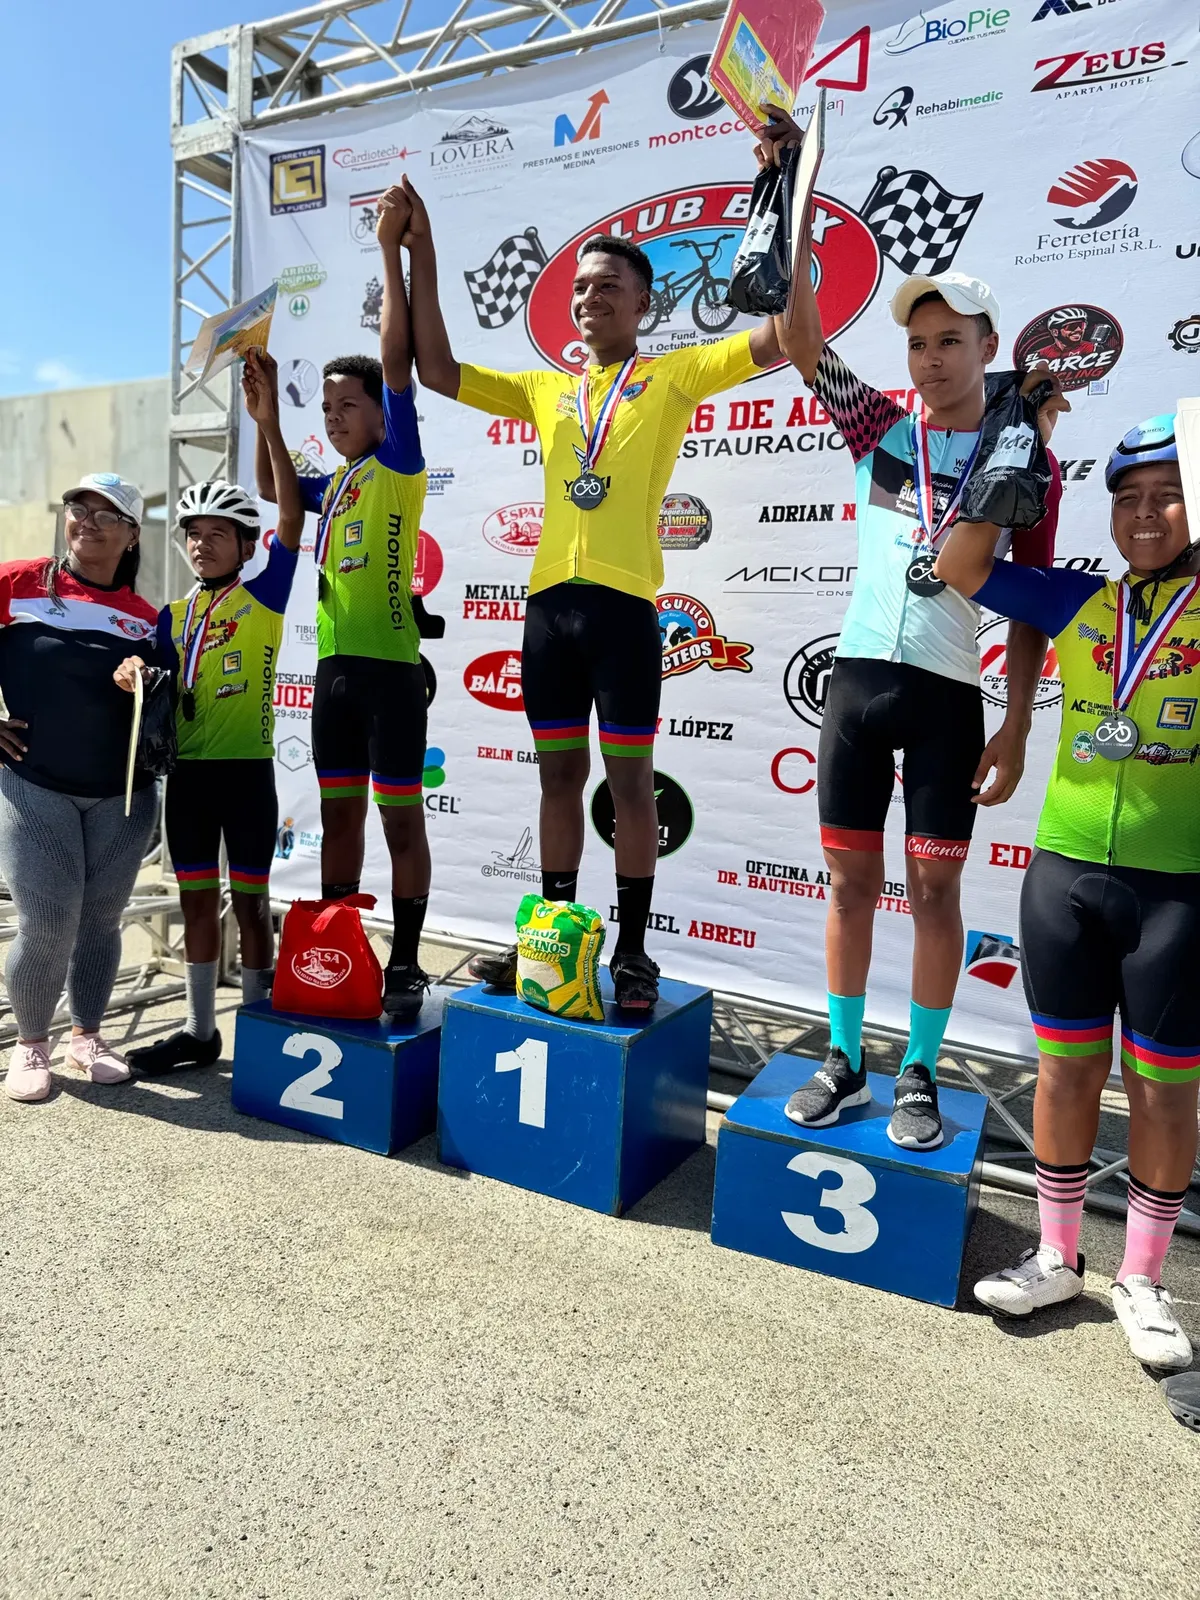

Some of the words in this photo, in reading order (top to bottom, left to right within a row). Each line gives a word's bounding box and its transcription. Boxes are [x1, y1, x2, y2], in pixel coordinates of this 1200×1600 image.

[925, 8, 1010, 43] BioPie
[1030, 41, 1166, 93] ZEUS
[1055, 85, 1104, 100] APARTA
[1110, 76, 1154, 90] HOTEL
[916, 91, 1003, 116] Rehabimedic
[342, 144, 400, 165] Cardiotech
[430, 137, 514, 167] LOVERA
[523, 152, 573, 169] PRESTAMOS
[582, 140, 640, 157] INVERSIONES
[563, 158, 596, 170] MEDINA
[288, 202, 323, 212] FUENTE
[1036, 223, 1141, 250] Ferretería
[1014, 250, 1064, 266] Roberto
[1068, 243, 1116, 260] Espinal
[1120, 239, 1162, 251] S.R.L.
[671, 331, 699, 341] Fund.
[1025, 353, 1040, 362] EL
[1053, 367, 1104, 380] CLING
[727, 399, 774, 431] DE
[677, 431, 847, 459] STAURACIO
[671, 515, 707, 527] MOTORS
[758, 503, 835, 523] ADRIAN
[387, 513, 405, 630] montecci
[262, 645, 274, 744] montecci
[469, 671, 523, 699] BALD
[669, 715, 734, 741] LÓPEZ
[477, 746, 514, 762] ERLIN
[907, 837, 967, 857] Calientes
[746, 859, 809, 882] OFICINA
[717, 870, 741, 886] DR.
[748, 875, 826, 900] BAUTISTA
[609, 905, 680, 934] DIEL
[687, 919, 757, 949] ABREU
[279, 1031, 344, 1121] 2
[495, 1037, 549, 1130] 1
[814, 1071, 838, 1094] adidas
[895, 1091, 933, 1107] adidas
[780, 1150, 880, 1255] 3
